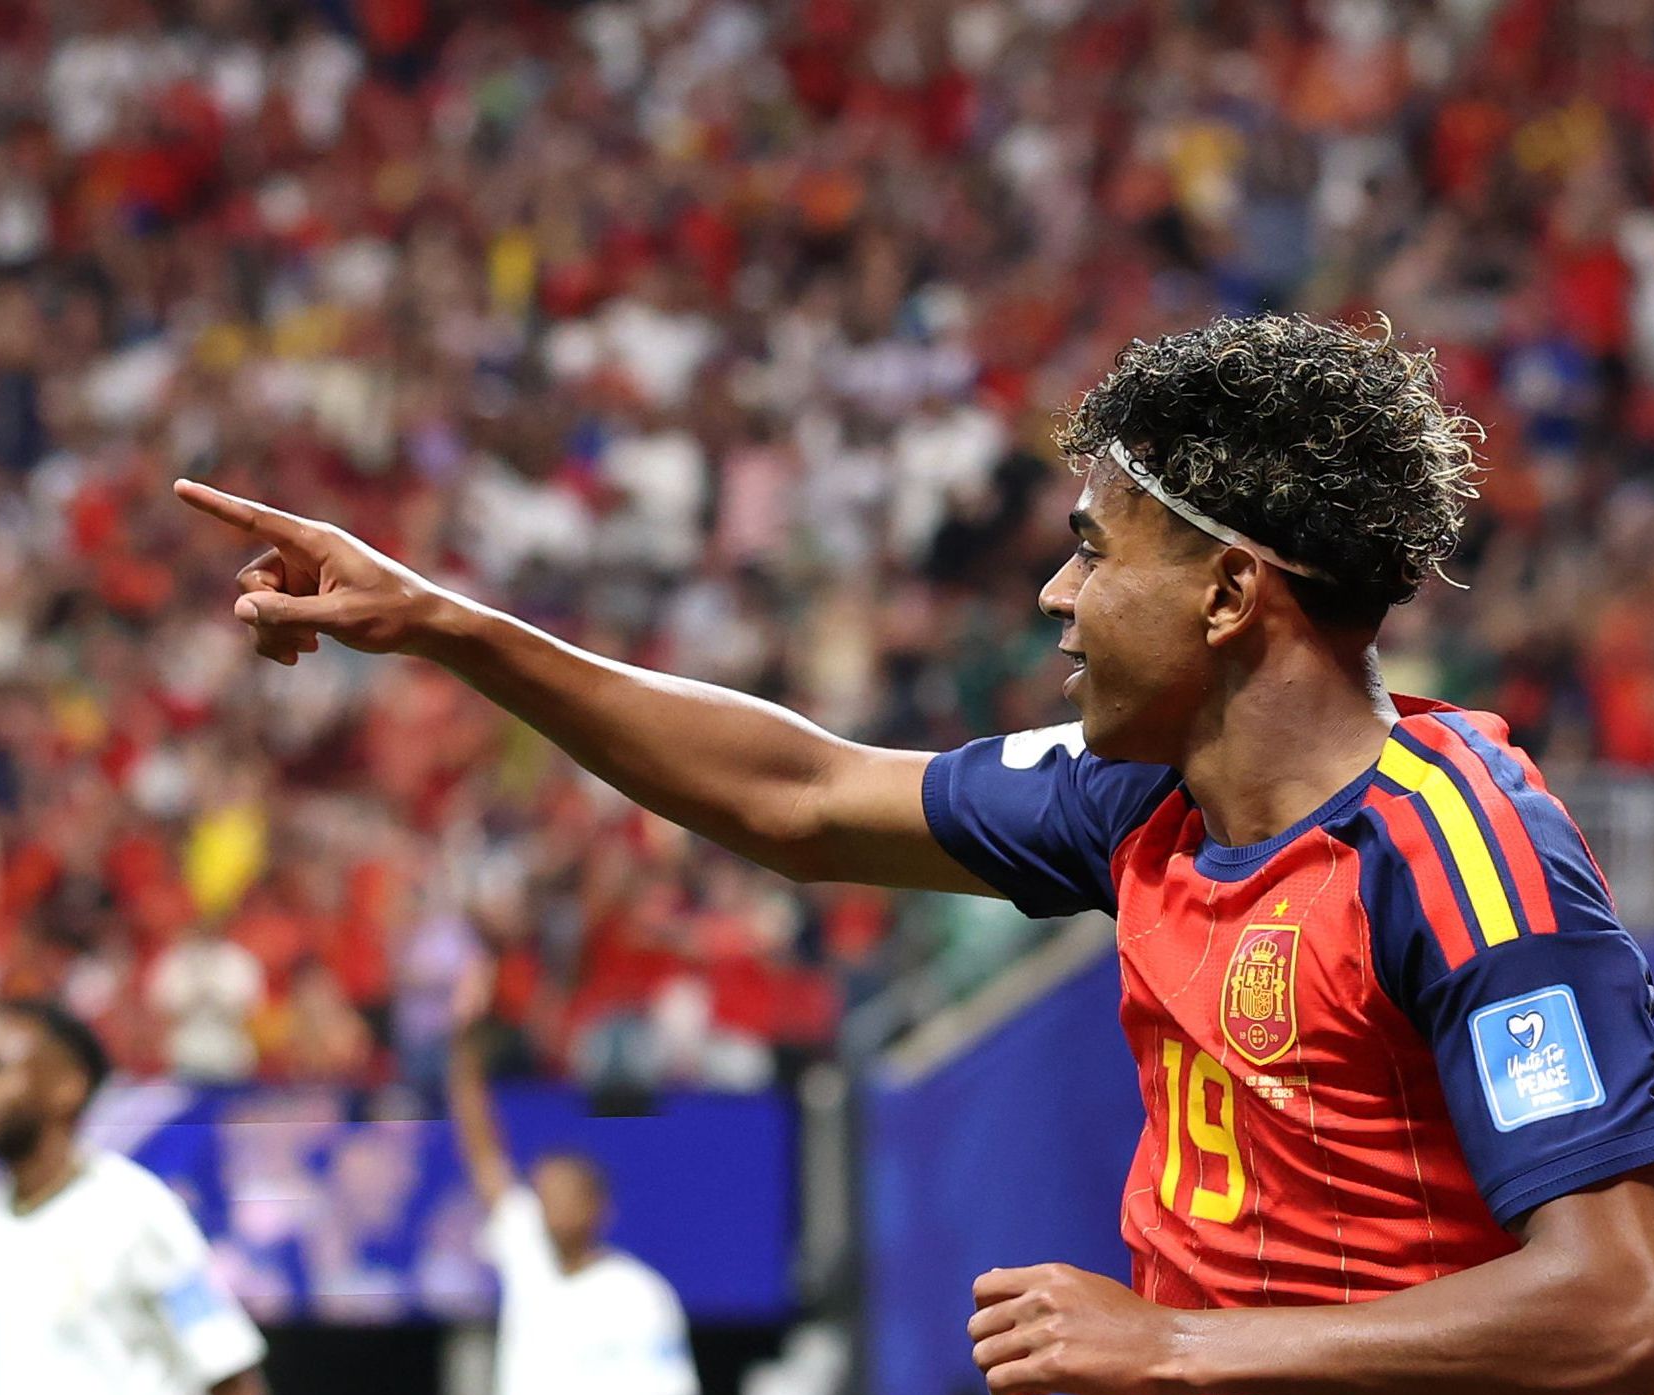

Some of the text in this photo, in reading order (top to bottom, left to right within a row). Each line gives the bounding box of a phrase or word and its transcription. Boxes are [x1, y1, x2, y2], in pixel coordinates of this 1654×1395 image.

[1507, 1052, 1544, 1079] Unite
[1515, 1064, 1570, 1098] PEACE
[1160, 1038, 1245, 1224] 19
